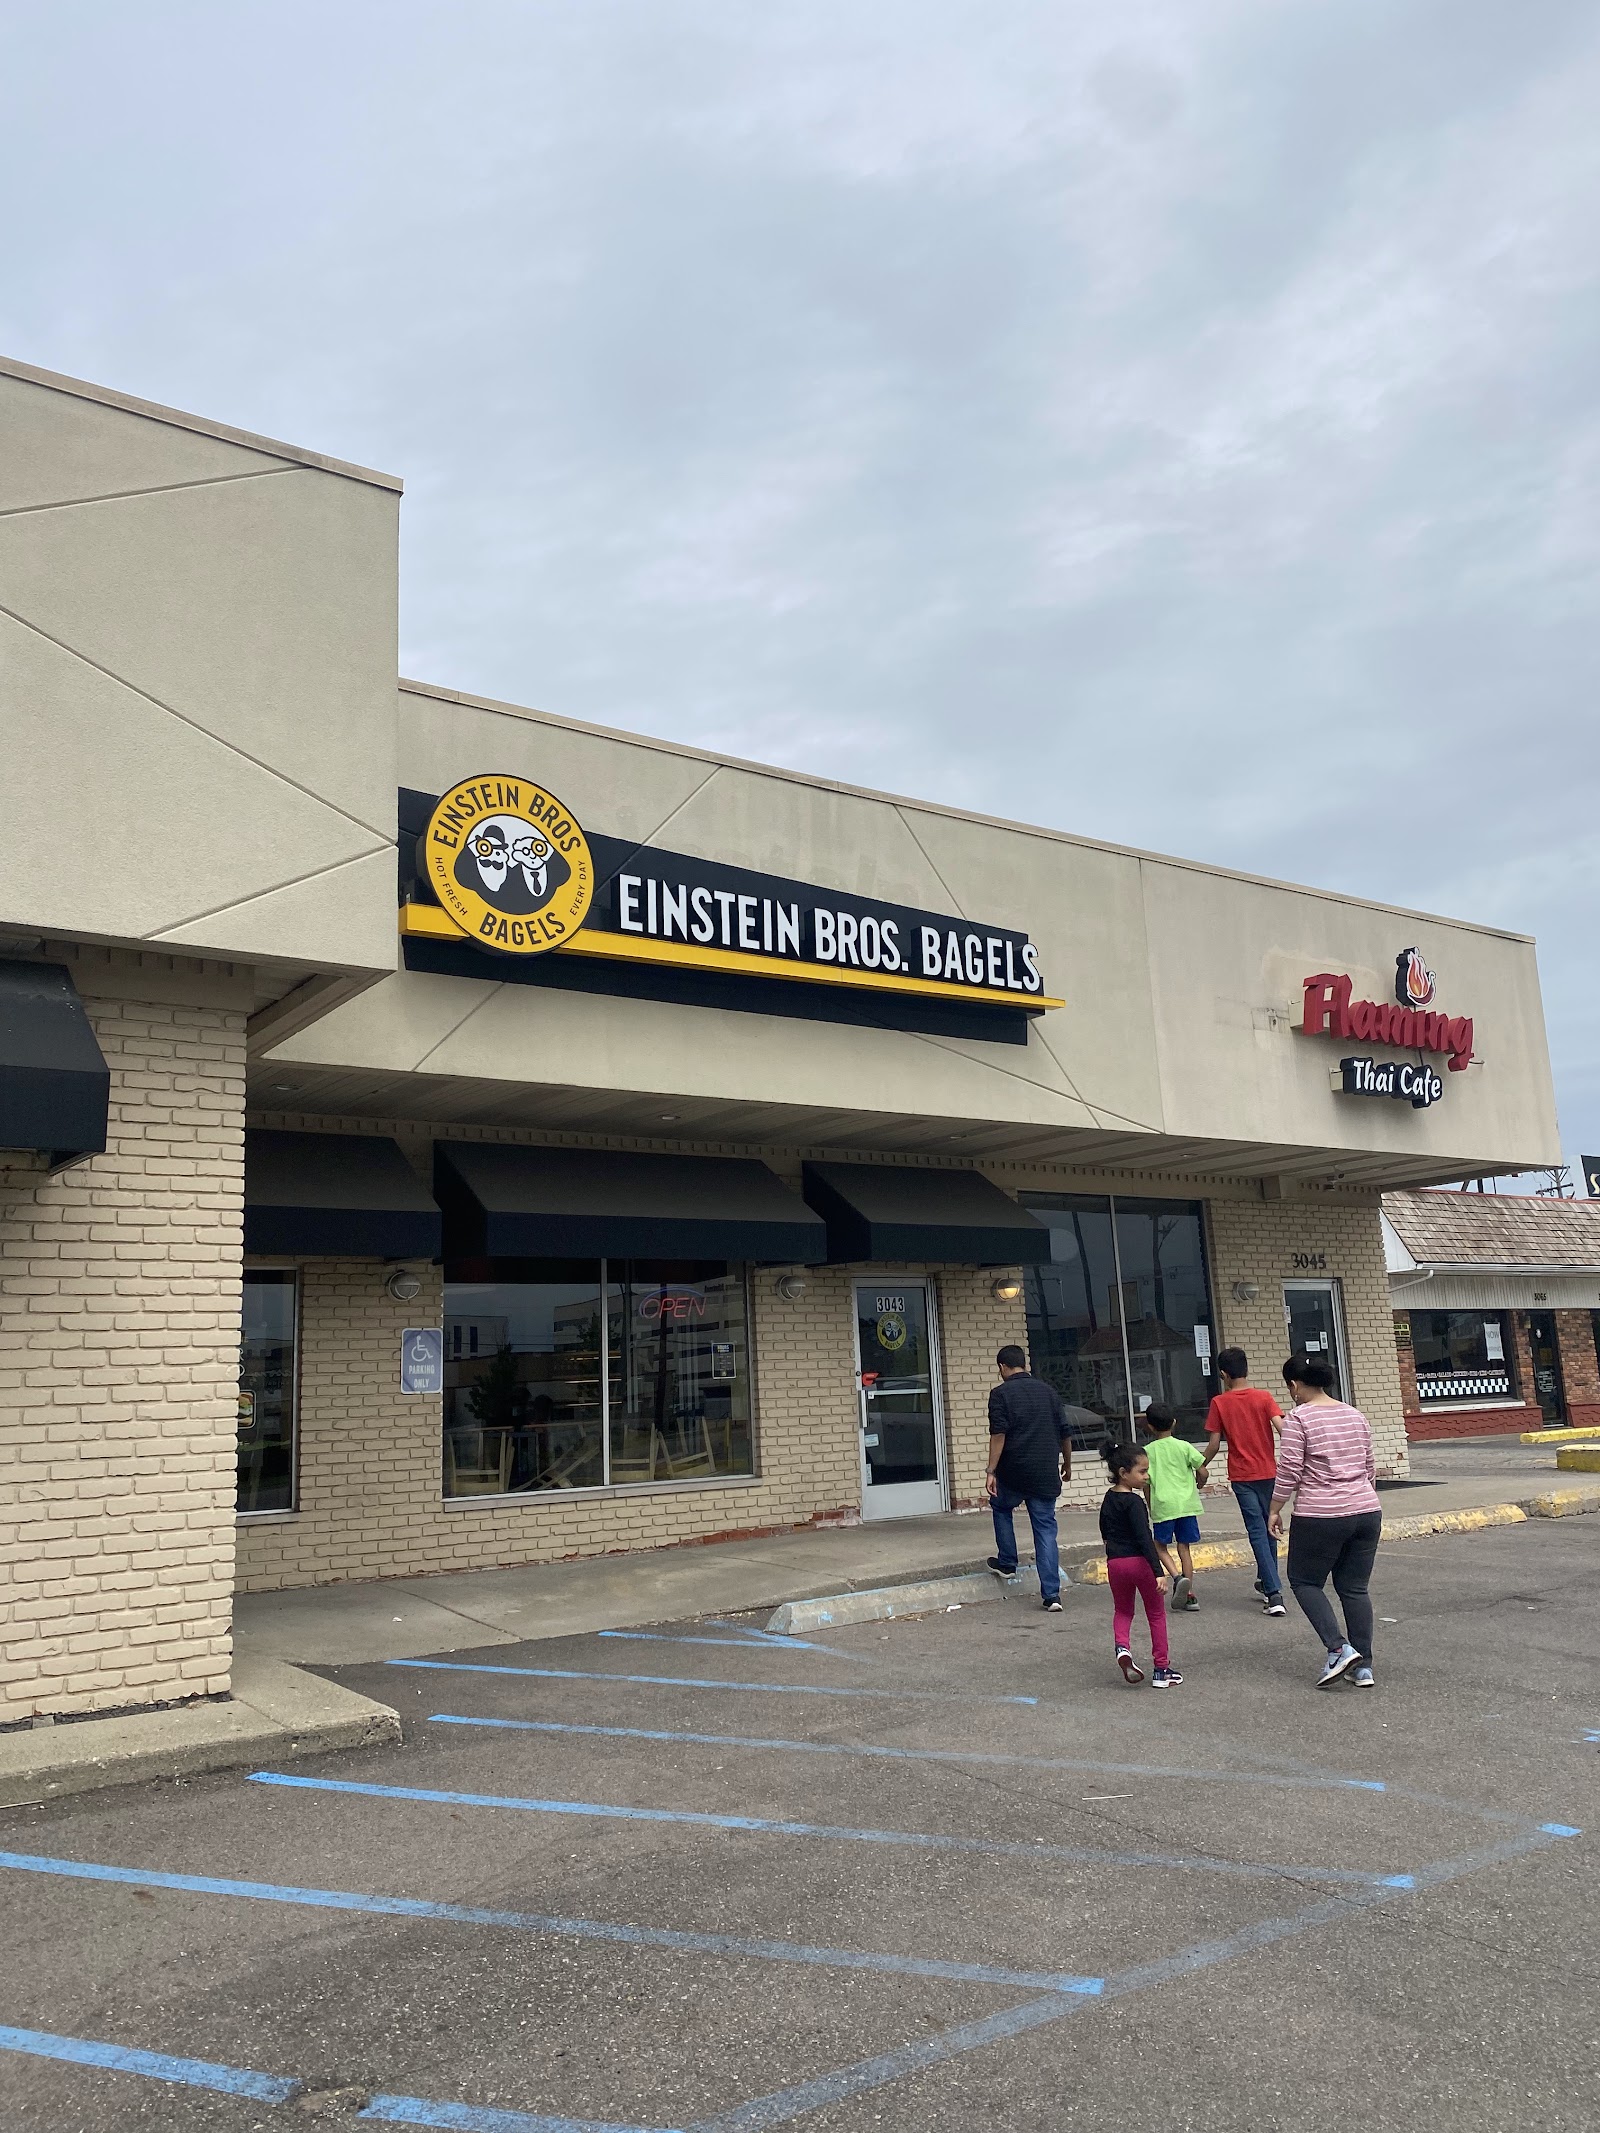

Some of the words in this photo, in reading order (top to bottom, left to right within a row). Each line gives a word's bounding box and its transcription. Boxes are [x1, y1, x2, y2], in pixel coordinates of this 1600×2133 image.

[433, 782, 519, 849] EINSTEIN
[528, 793, 581, 852] BROS
[434, 857, 447, 879] HOT
[442, 883, 467, 916] FRESH
[569, 884, 586, 916] EVERY
[579, 860, 587, 880] DAY
[479, 911, 566, 946] BAGELS
[619, 873, 801, 958] EINSTEIN
[814, 907, 910, 972] BROS.
[921, 925, 1041, 992] BAGELS
[1303, 973, 1475, 1072] Flaming
[1353, 1060, 1395, 1092] Thai
[1400, 1065, 1441, 1104] Cafe
[1291, 1253, 1327, 1270] 3045
[643, 1297, 707, 1319] OPEN
[877, 1297, 904, 1312] 3043
[408, 1364, 435, 1375] PARKING
[413, 1378, 430, 1389] ONLY
